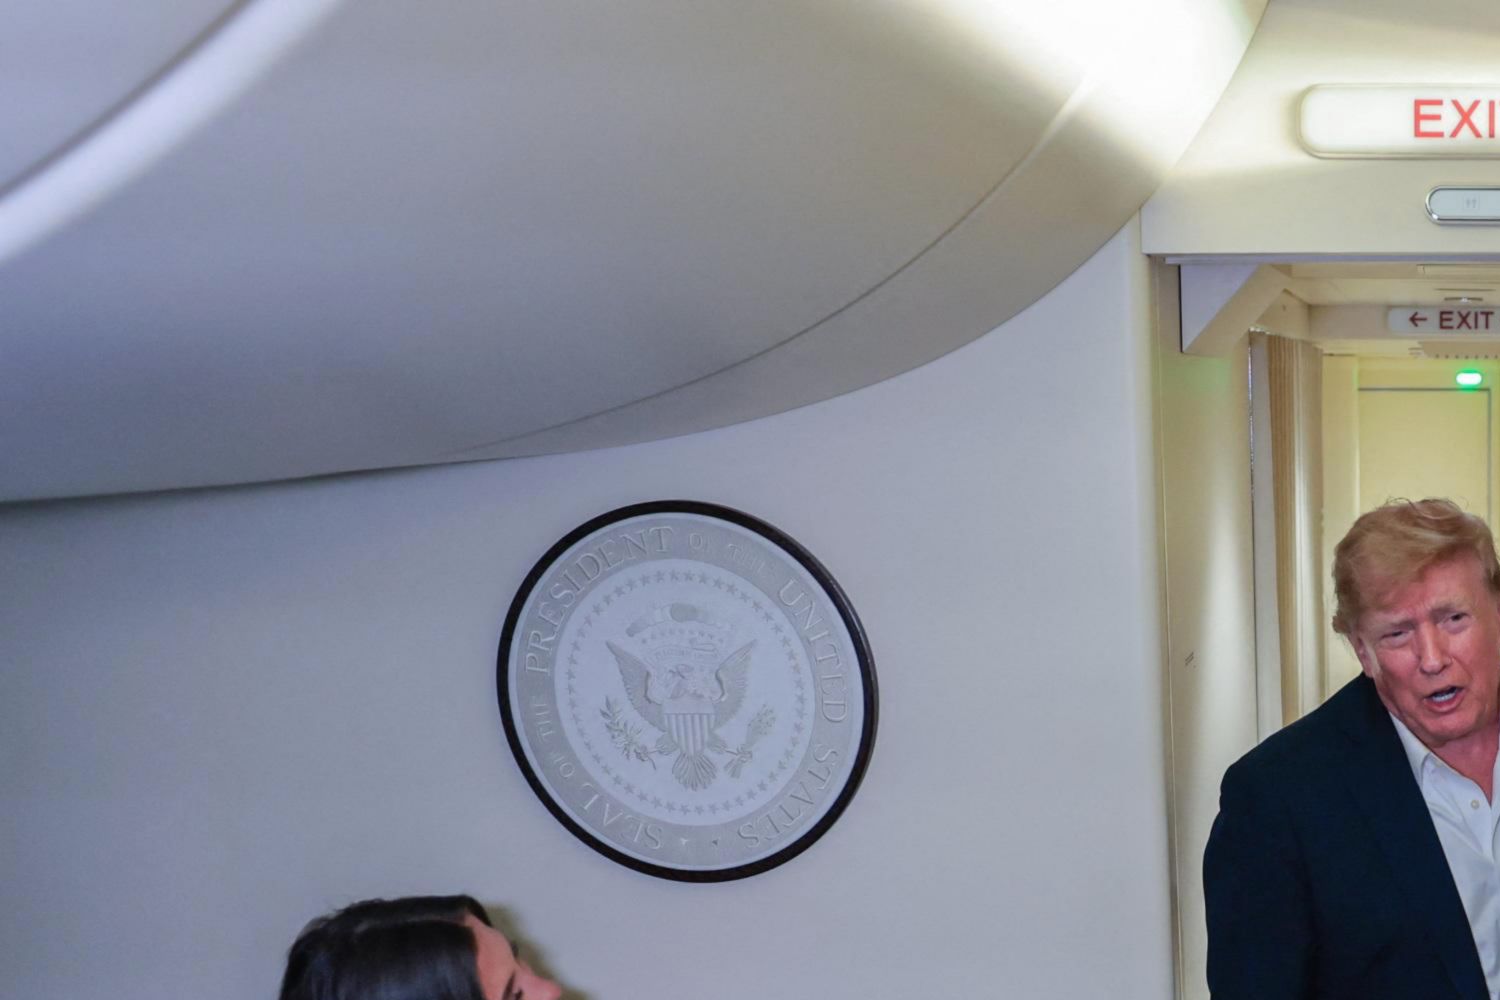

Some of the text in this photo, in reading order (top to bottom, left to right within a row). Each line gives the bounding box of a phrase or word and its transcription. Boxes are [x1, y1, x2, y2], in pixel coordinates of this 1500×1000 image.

[1439, 311, 1494, 329] EXIT
[525, 525, 674, 677] PRESIDENT
[778, 578, 848, 724] UNITED
[581, 781, 662, 850] SEAL
[737, 742, 842, 849] STATES
